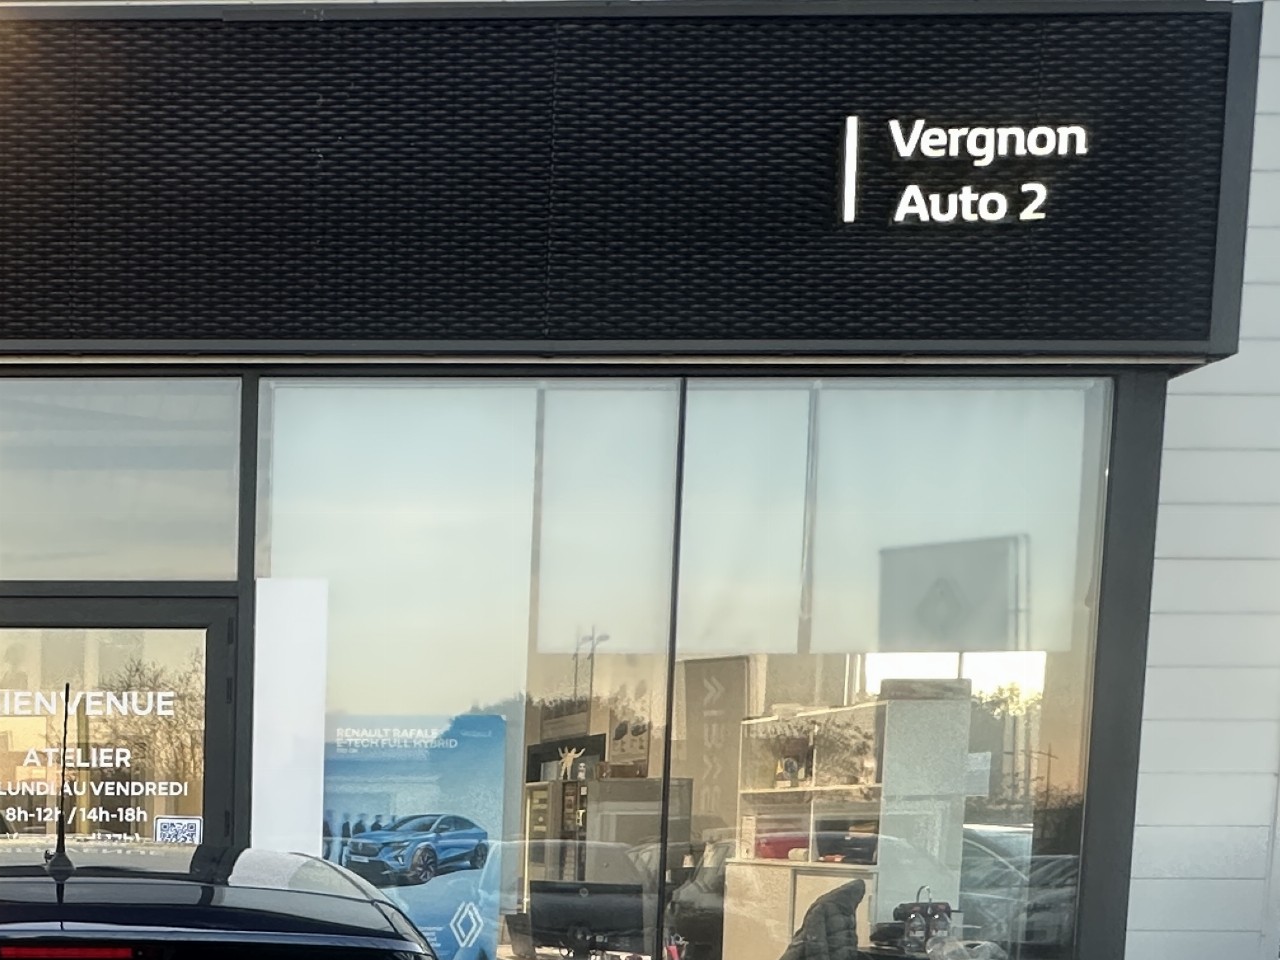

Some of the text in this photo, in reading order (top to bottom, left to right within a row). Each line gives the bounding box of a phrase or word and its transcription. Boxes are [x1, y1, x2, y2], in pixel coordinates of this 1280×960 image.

[888, 119, 1088, 167] Vergnon
[893, 182, 1048, 222] Auto 2
[336, 727, 392, 739] RENAULT
[380, 738, 413, 749] FULL
[22, 748, 132, 769] ATELIER
[62, 780, 87, 797] AU
[89, 780, 189, 797] VENDREDI
[81, 806, 148, 823] 14h-18h
